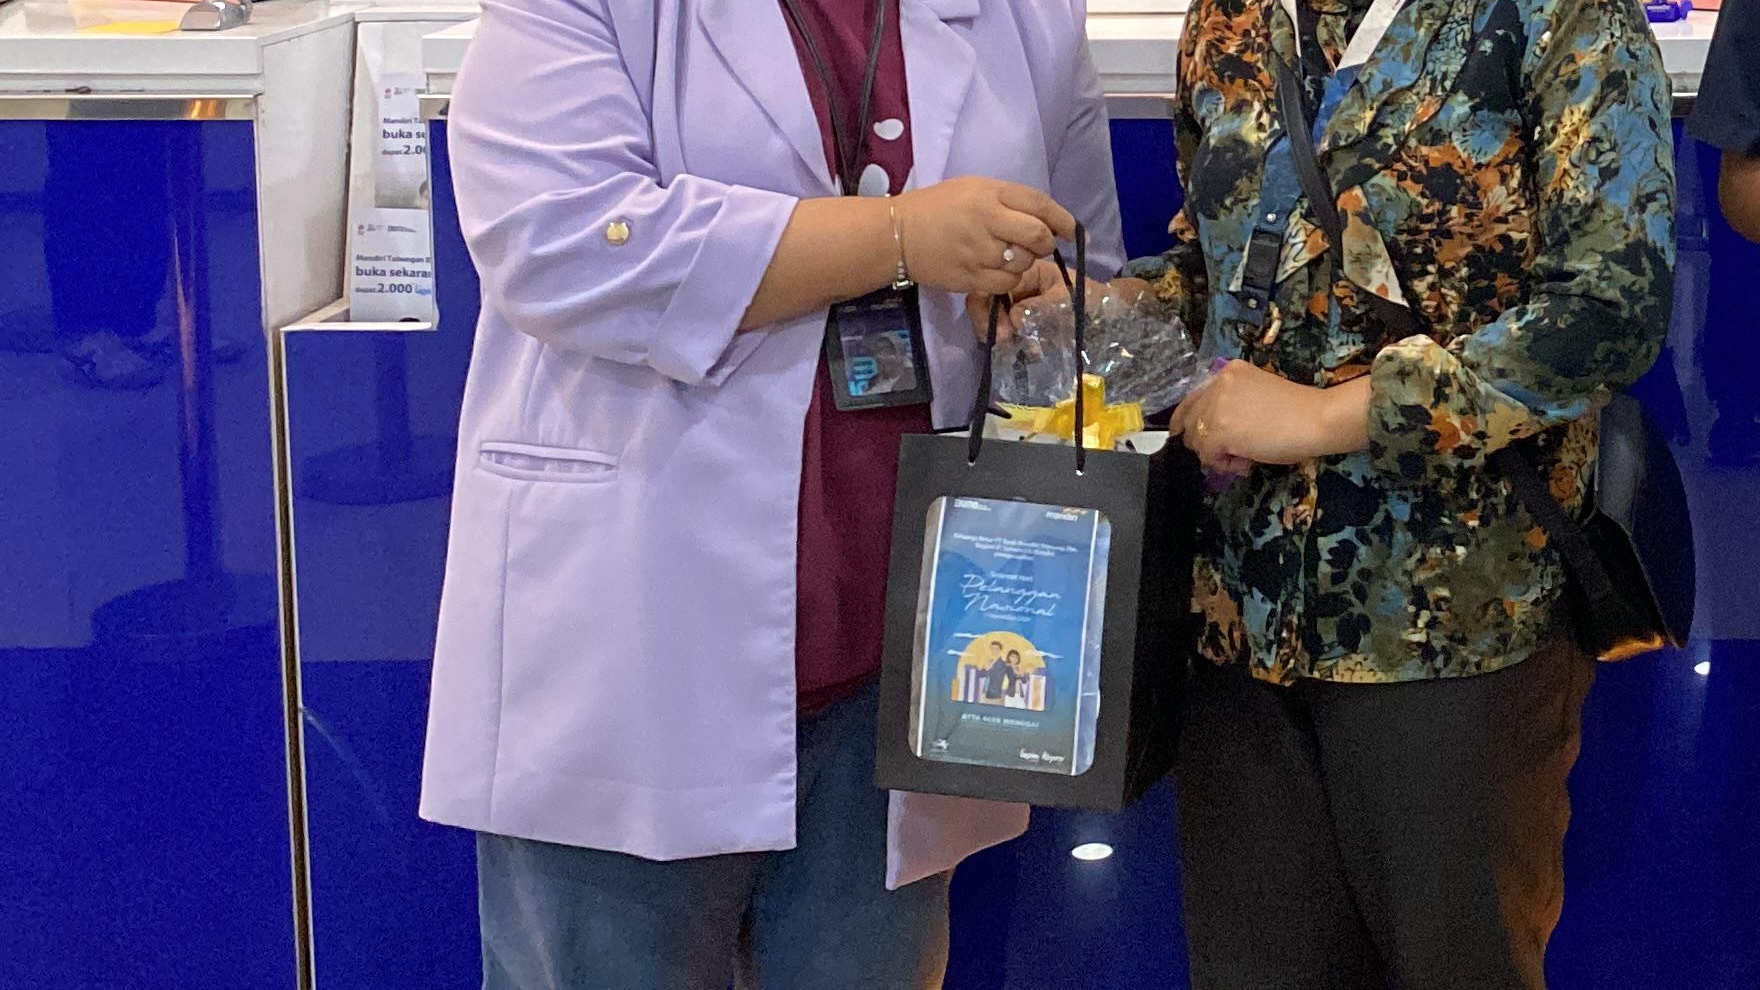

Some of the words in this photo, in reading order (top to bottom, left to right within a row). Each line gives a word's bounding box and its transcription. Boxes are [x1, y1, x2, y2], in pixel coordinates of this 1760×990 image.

[382, 128, 413, 139] buka
[355, 265, 387, 277] buka
[377, 282, 413, 294] 2.000
